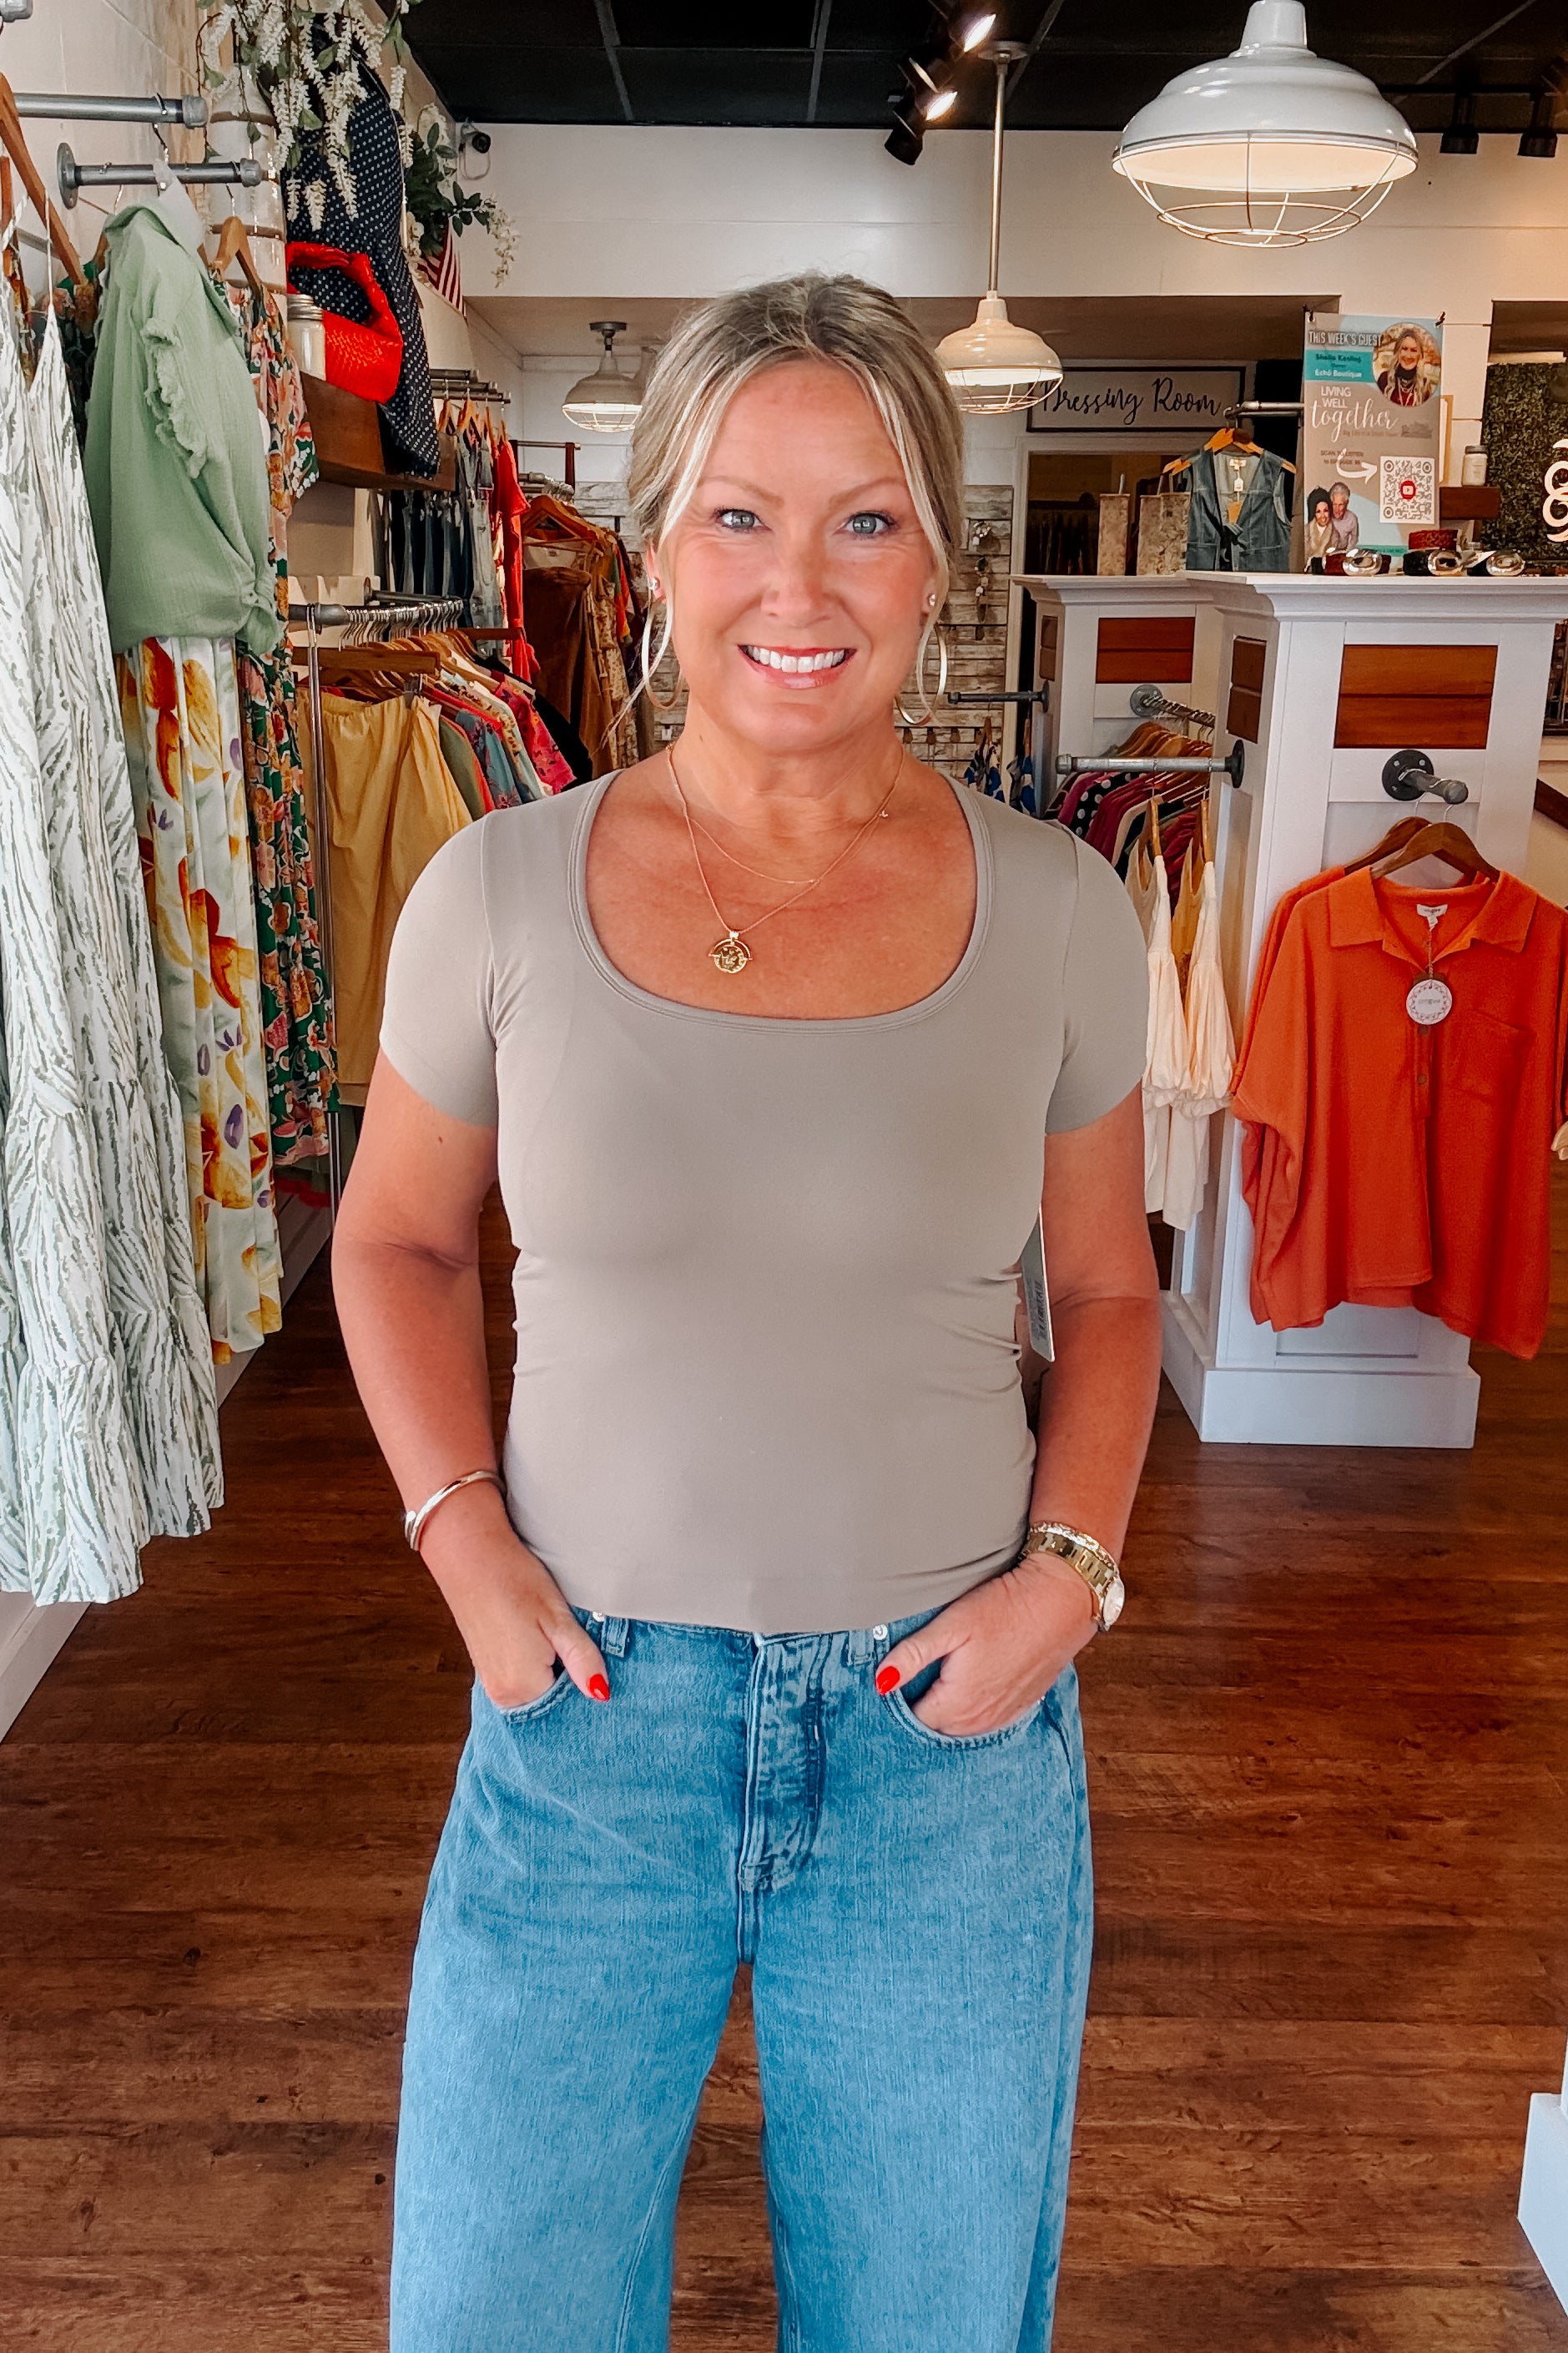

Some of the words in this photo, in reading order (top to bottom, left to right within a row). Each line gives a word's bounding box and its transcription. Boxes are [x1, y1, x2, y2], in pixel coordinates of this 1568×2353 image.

[1308, 331, 1326, 344] THIS
[1328, 332, 1357, 346] WEEK'S
[1359, 333, 1382, 346] GUEST
[1321, 386, 1352, 396] LIVING
[1040, 380, 1143, 425] Dressing
[1151, 376, 1222, 416] Room
[1322, 398, 1348, 408] WELL
[1311, 398, 1399, 442] together
